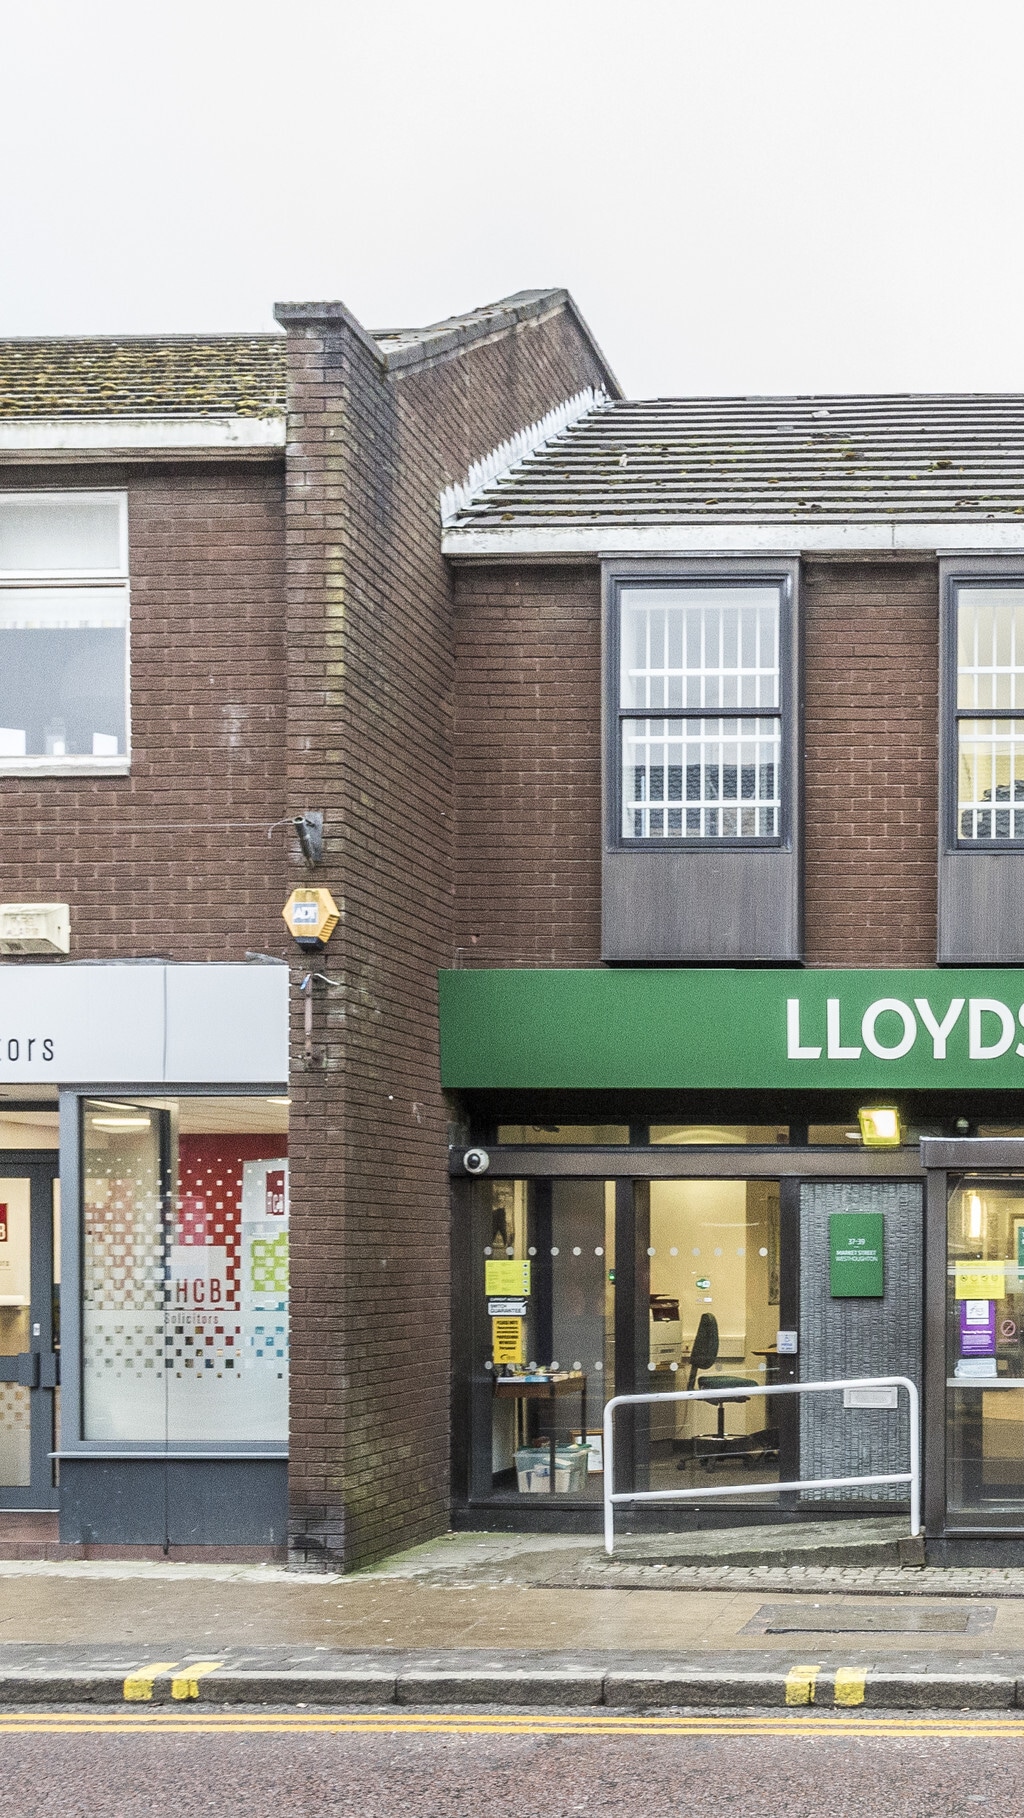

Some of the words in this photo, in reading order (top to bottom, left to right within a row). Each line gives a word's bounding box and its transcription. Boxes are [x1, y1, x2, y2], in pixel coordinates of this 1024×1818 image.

[294, 905, 317, 920] ADT
[0, 1038, 54, 1062] ors
[176, 1278, 221, 1303] HCB
[164, 1312, 219, 1325] Solicitors
